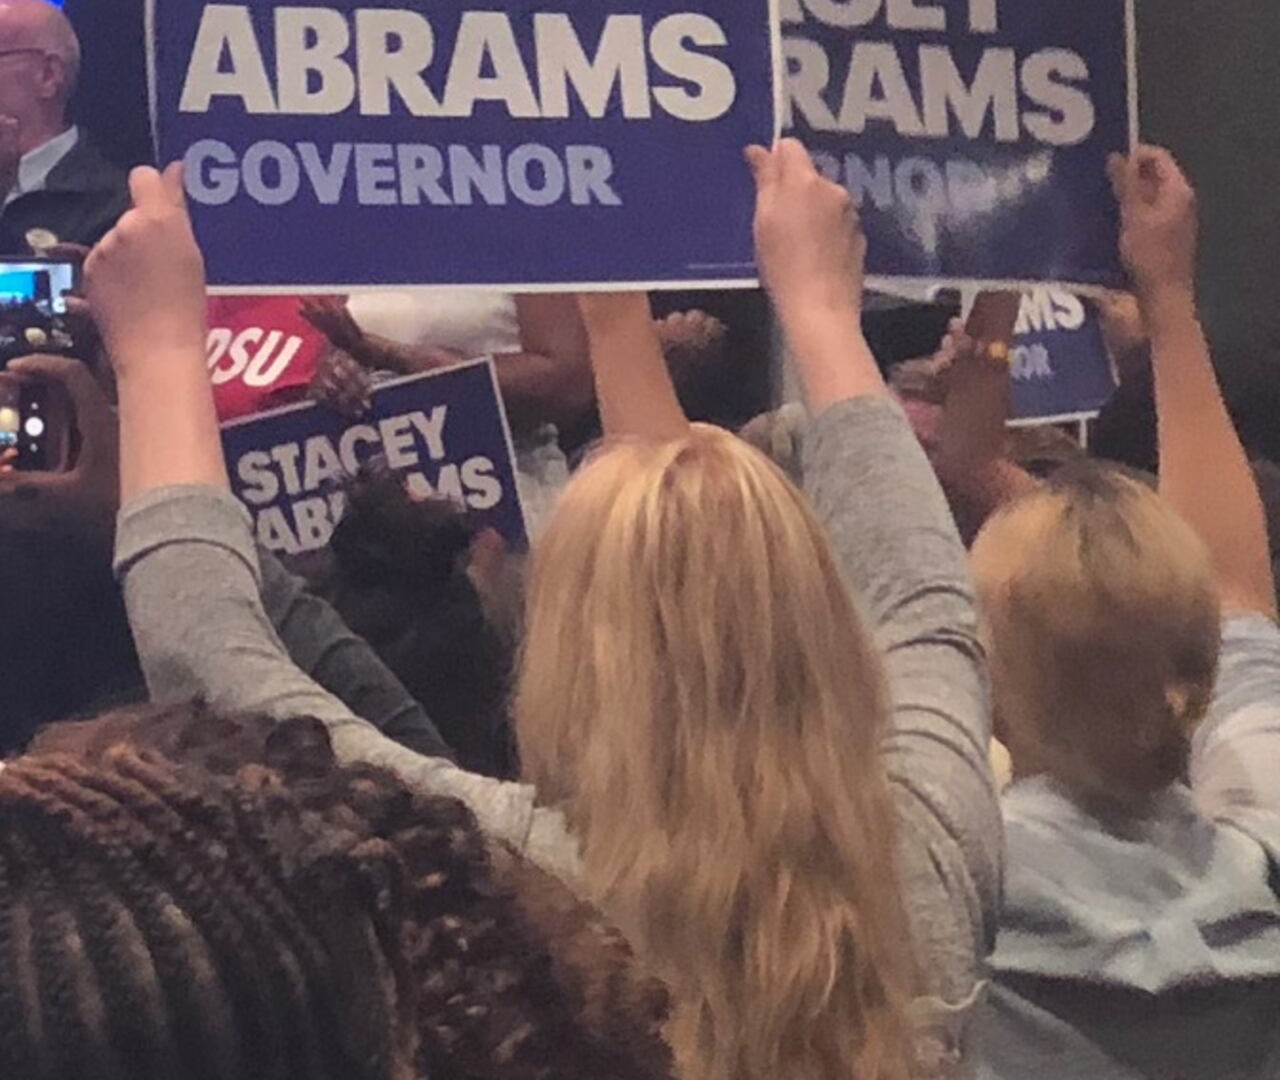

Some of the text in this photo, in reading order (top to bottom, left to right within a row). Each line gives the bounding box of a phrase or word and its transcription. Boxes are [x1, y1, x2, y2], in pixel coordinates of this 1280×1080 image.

[178, 3, 737, 121] ABRAMS
[781, 35, 1096, 146] RAMS
[183, 138, 622, 207] GOVERNOR
[237, 404, 448, 506] STACEY
